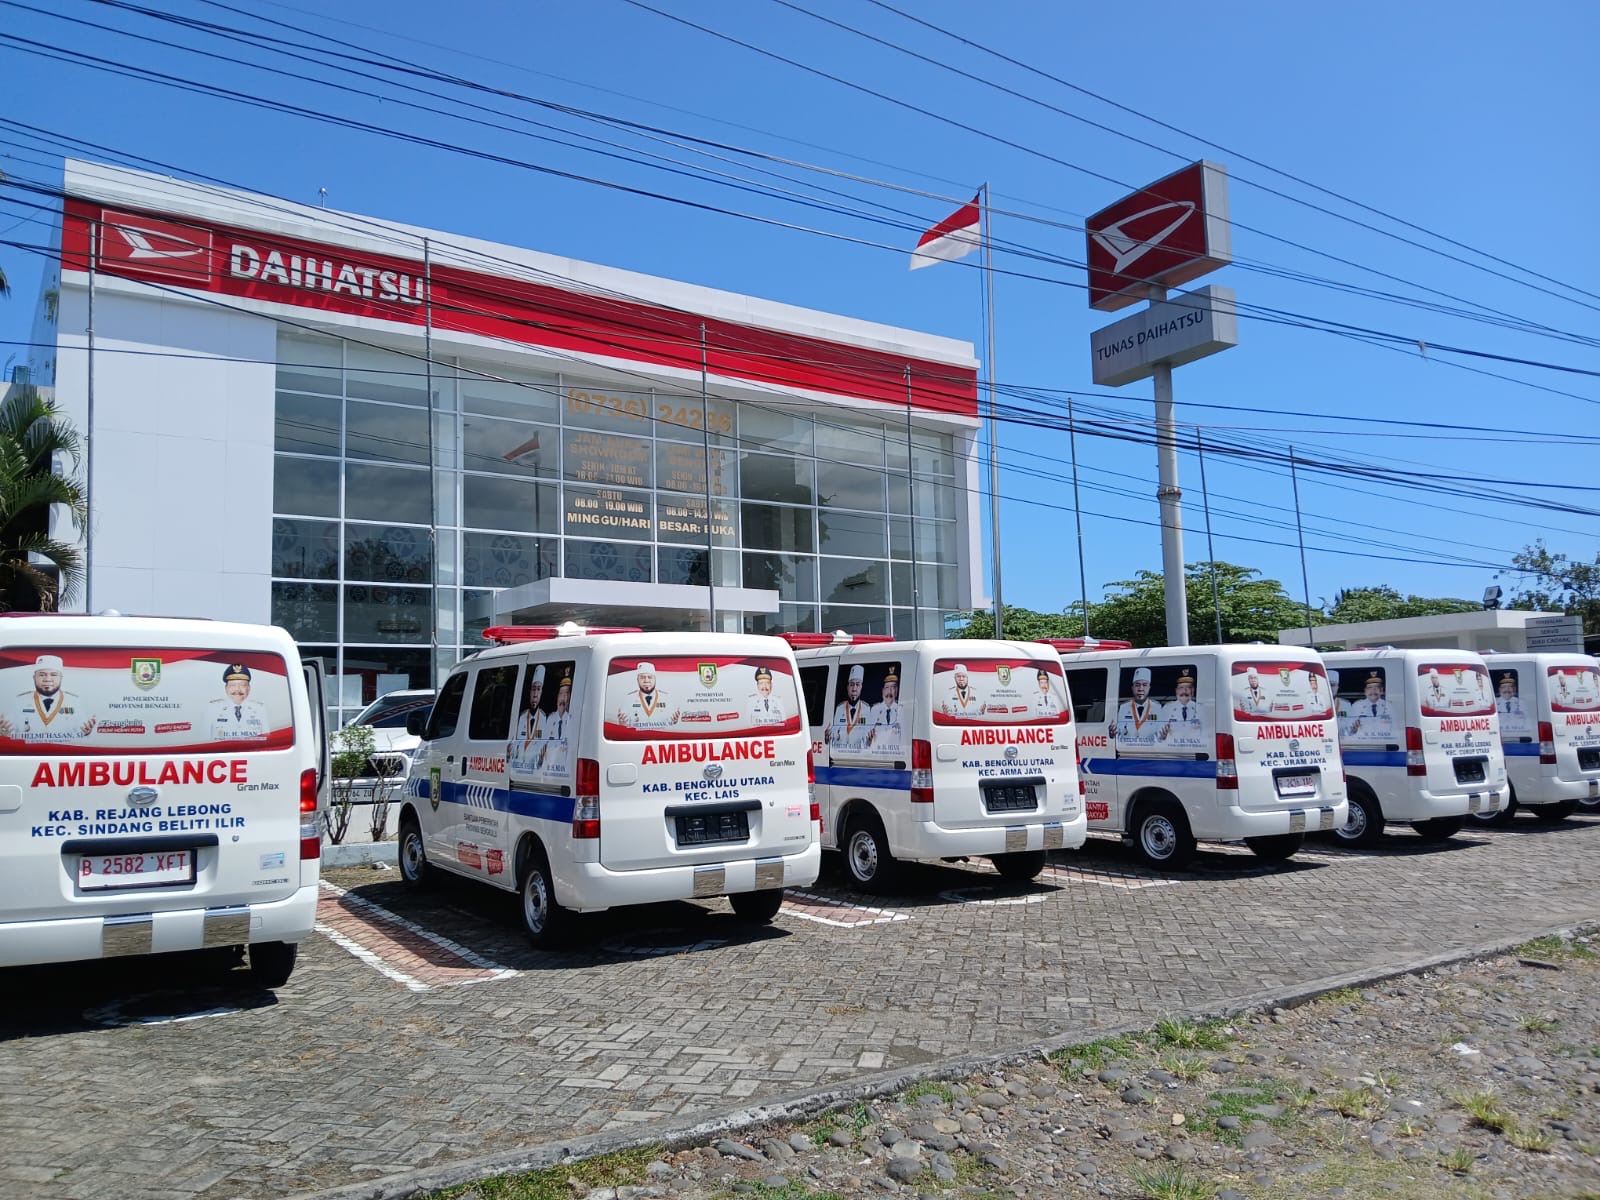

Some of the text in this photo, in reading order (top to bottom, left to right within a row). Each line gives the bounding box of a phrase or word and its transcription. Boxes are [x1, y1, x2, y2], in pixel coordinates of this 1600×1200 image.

[229, 243, 424, 305] DAIHATSU
[1096, 310, 1204, 361] TUNAS DAIHATSU
[567, 388, 647, 424] (0736)
[596, 489, 623, 501] SABTU
[575, 497, 599, 509] 08.00
[605, 501, 626, 511] 19.00
[627, 502, 644, 513] WIB
[666, 507, 688, 517] 08.00
[567, 512, 651, 529] MINGGU/HARI
[659, 520, 701, 533] BESAR:
[1256, 724, 1325, 740] AMBULANCE
[1440, 719, 1490, 732] AMBULANCE
[960, 728, 1054, 746] AMBULANCE
[641, 740, 776, 765] AMBULANCE
[1266, 750, 1321, 759] KAB. LEBONG
[469, 756, 505, 773] AMBULANCE
[962, 758, 1055, 768] KAB. BENGKULU UTARA
[1284, 758, 1307, 766] URAM
[30, 759, 248, 787] AMBULANCE
[978, 767, 1043, 777] KEC. ARMA JAYA
[237, 782, 280, 792] Gran Max
[642, 776, 775, 793] KAB. BENGKULU UTARA
[685, 789, 740, 801] KEC. LAIS
[48, 803, 232, 822] KAB. REJANG LEBONG
[31, 816, 245, 837] KEC. SINDANG BELITI ILIR
[82, 853, 186, 876] B 2582 XFT
